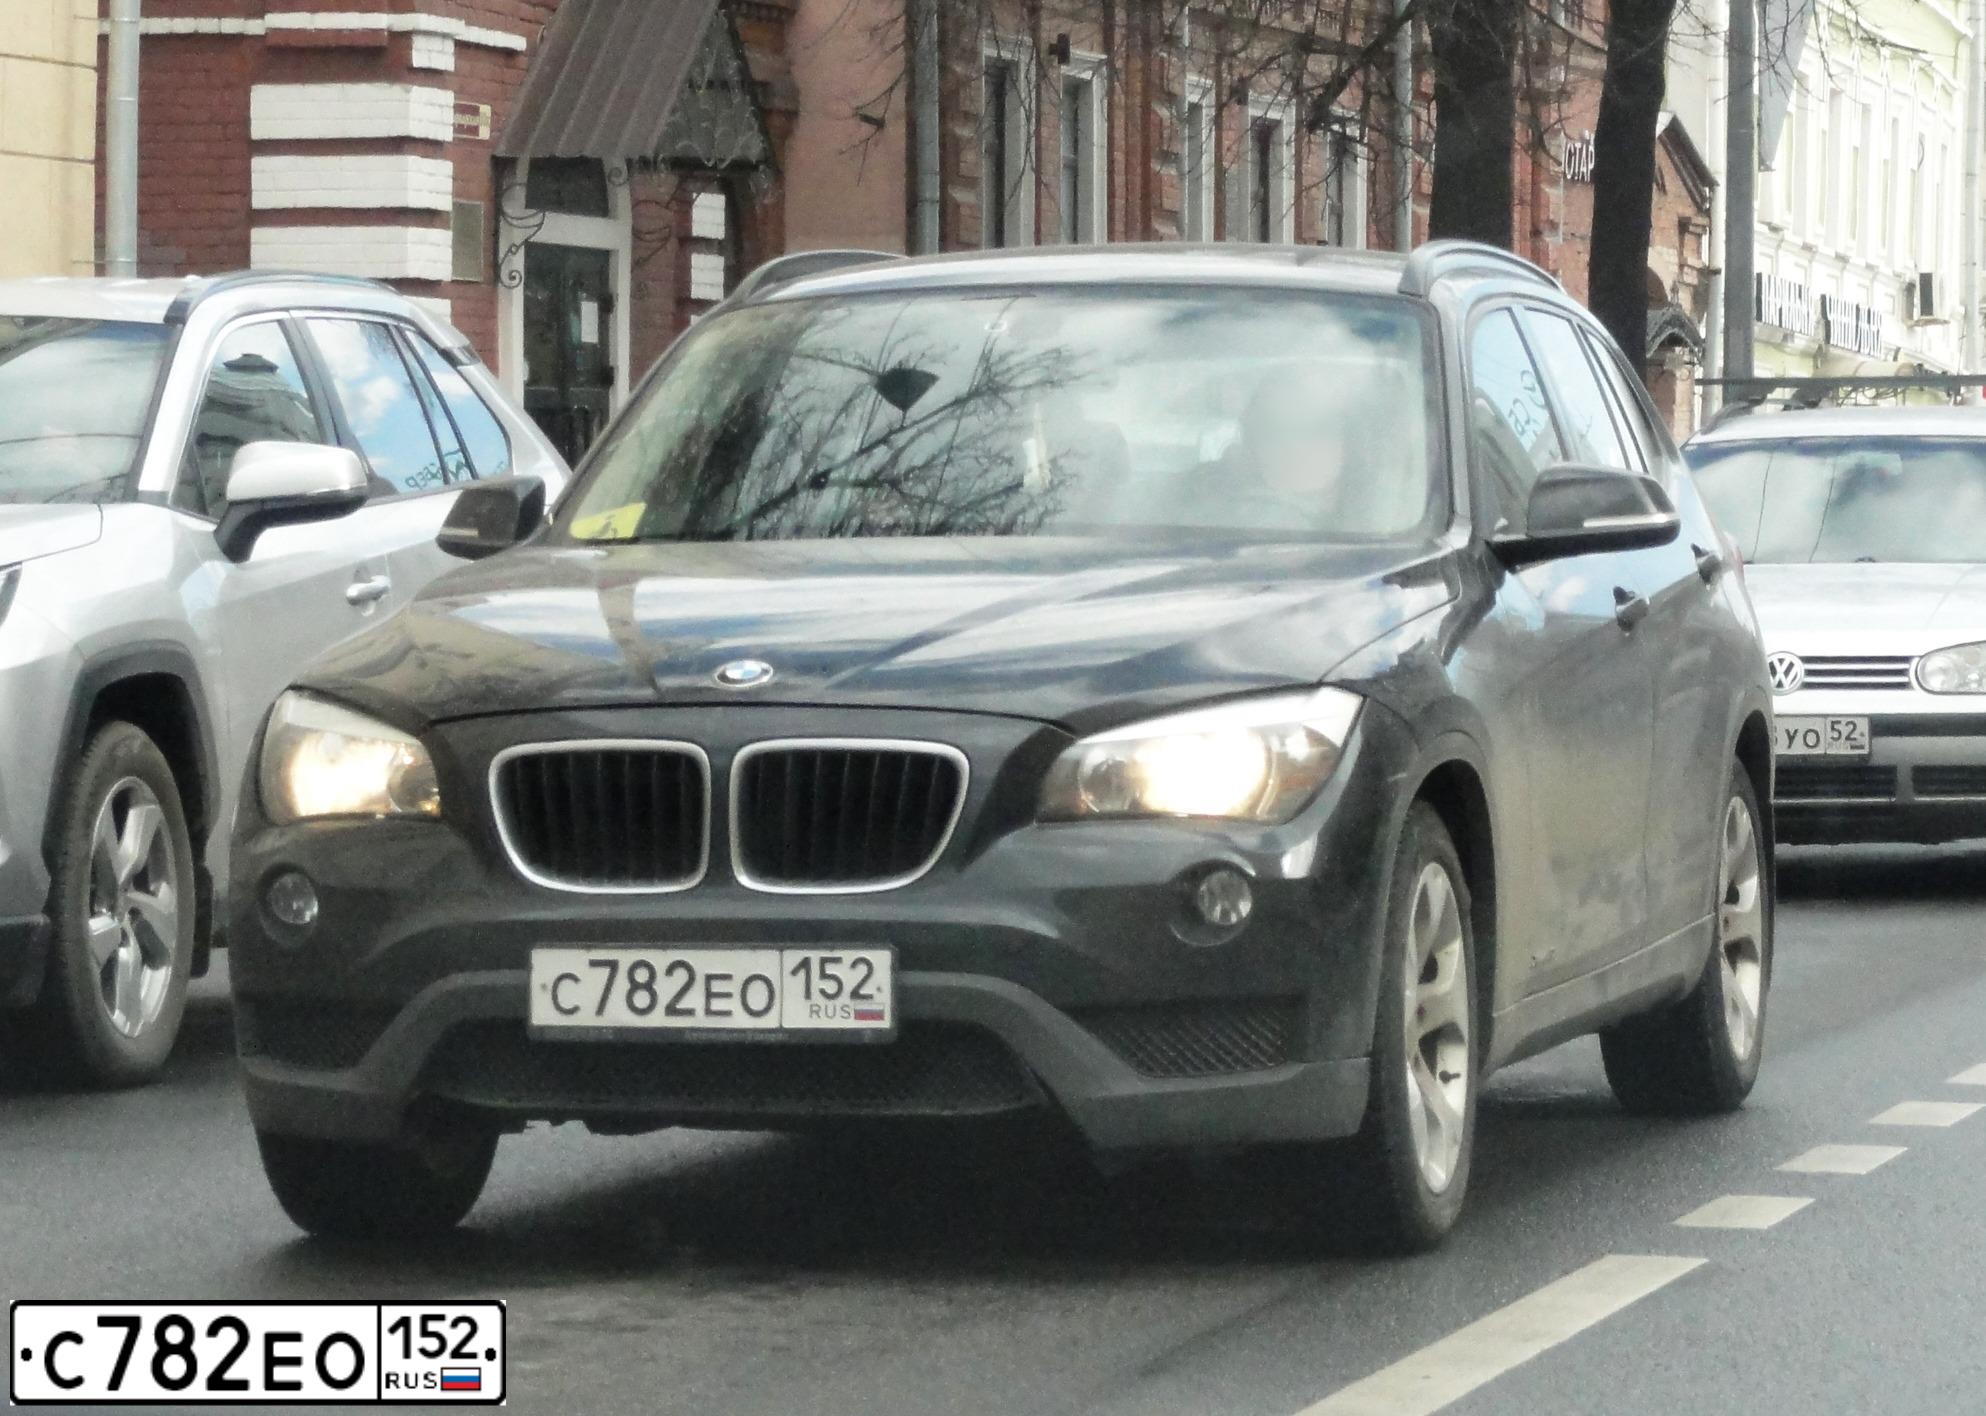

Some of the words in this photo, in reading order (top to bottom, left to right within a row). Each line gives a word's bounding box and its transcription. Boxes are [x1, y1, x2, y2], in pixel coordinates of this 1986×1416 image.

[1829, 720, 1858, 742] 52
[790, 956, 875, 1001] 152
[809, 1003, 852, 1020] RUS
